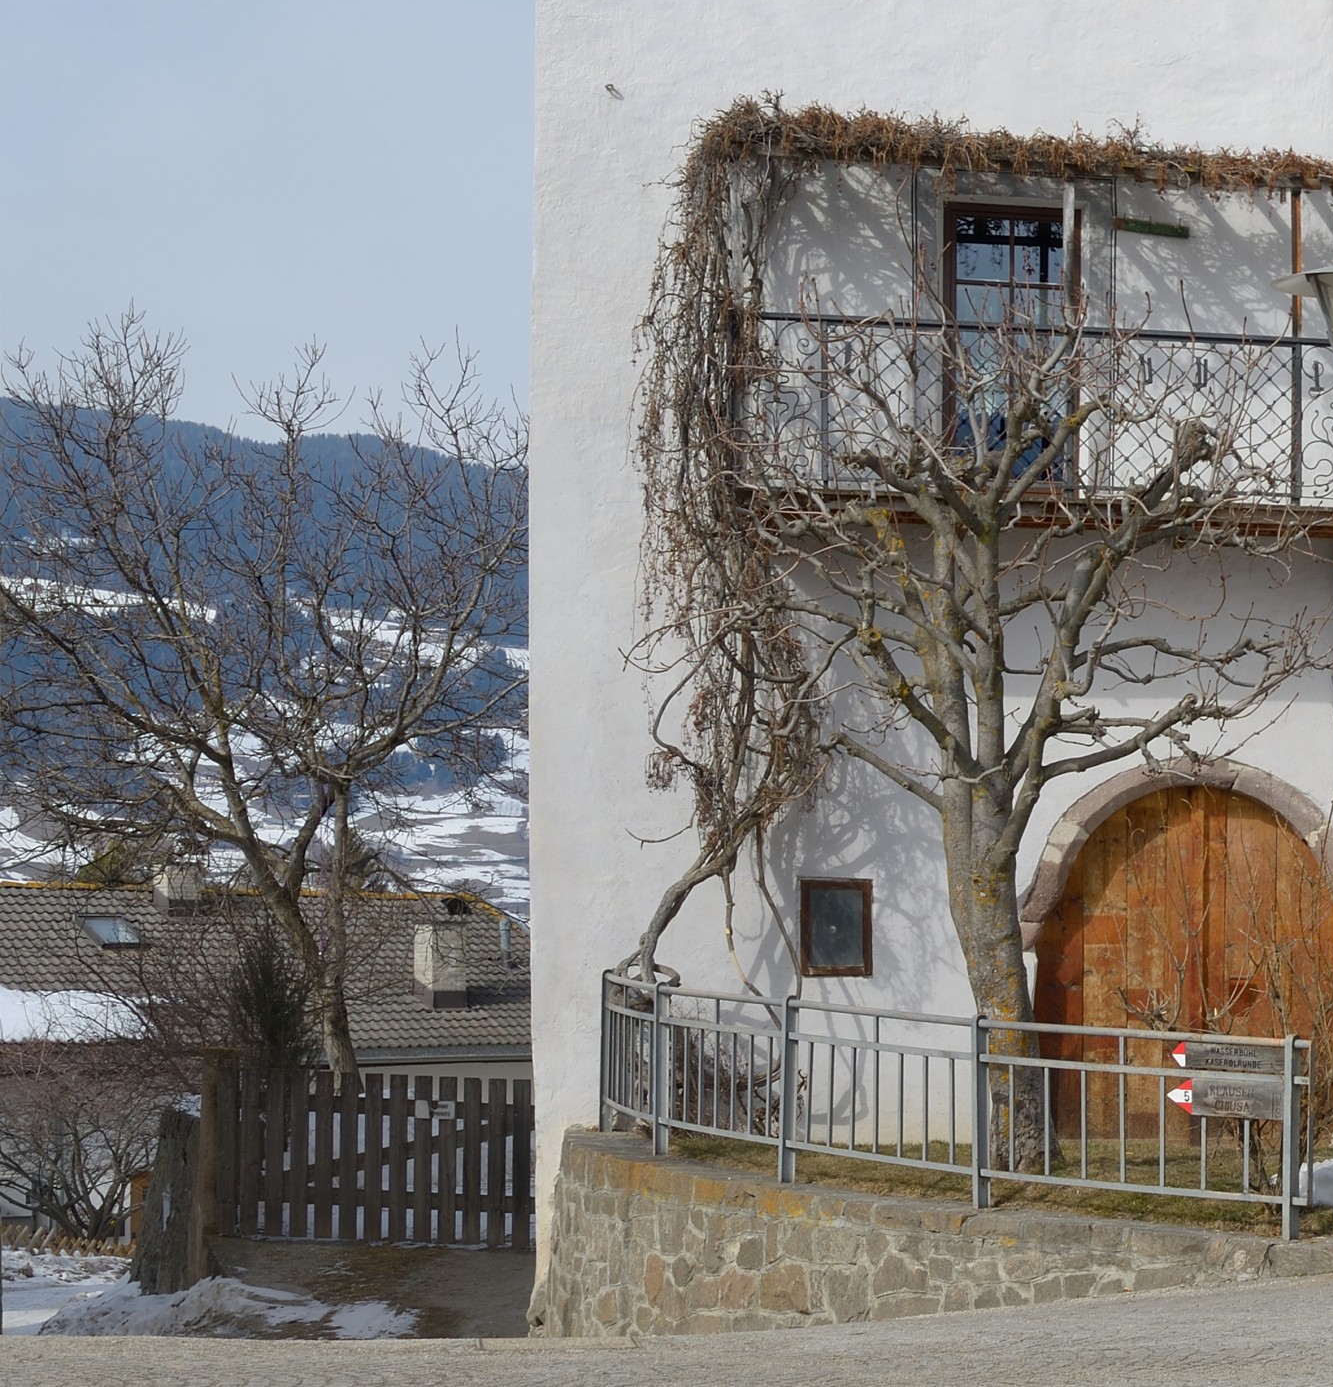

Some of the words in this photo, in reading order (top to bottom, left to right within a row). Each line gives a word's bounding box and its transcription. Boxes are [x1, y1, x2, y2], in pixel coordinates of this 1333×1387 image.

[1210, 1046, 1258, 1058] WASSERBÜHL
[1184, 1091, 1190, 1102] 5
[1209, 1085, 1255, 1098] KLAUSEN
[1214, 1099, 1250, 1113] CHIUSA
